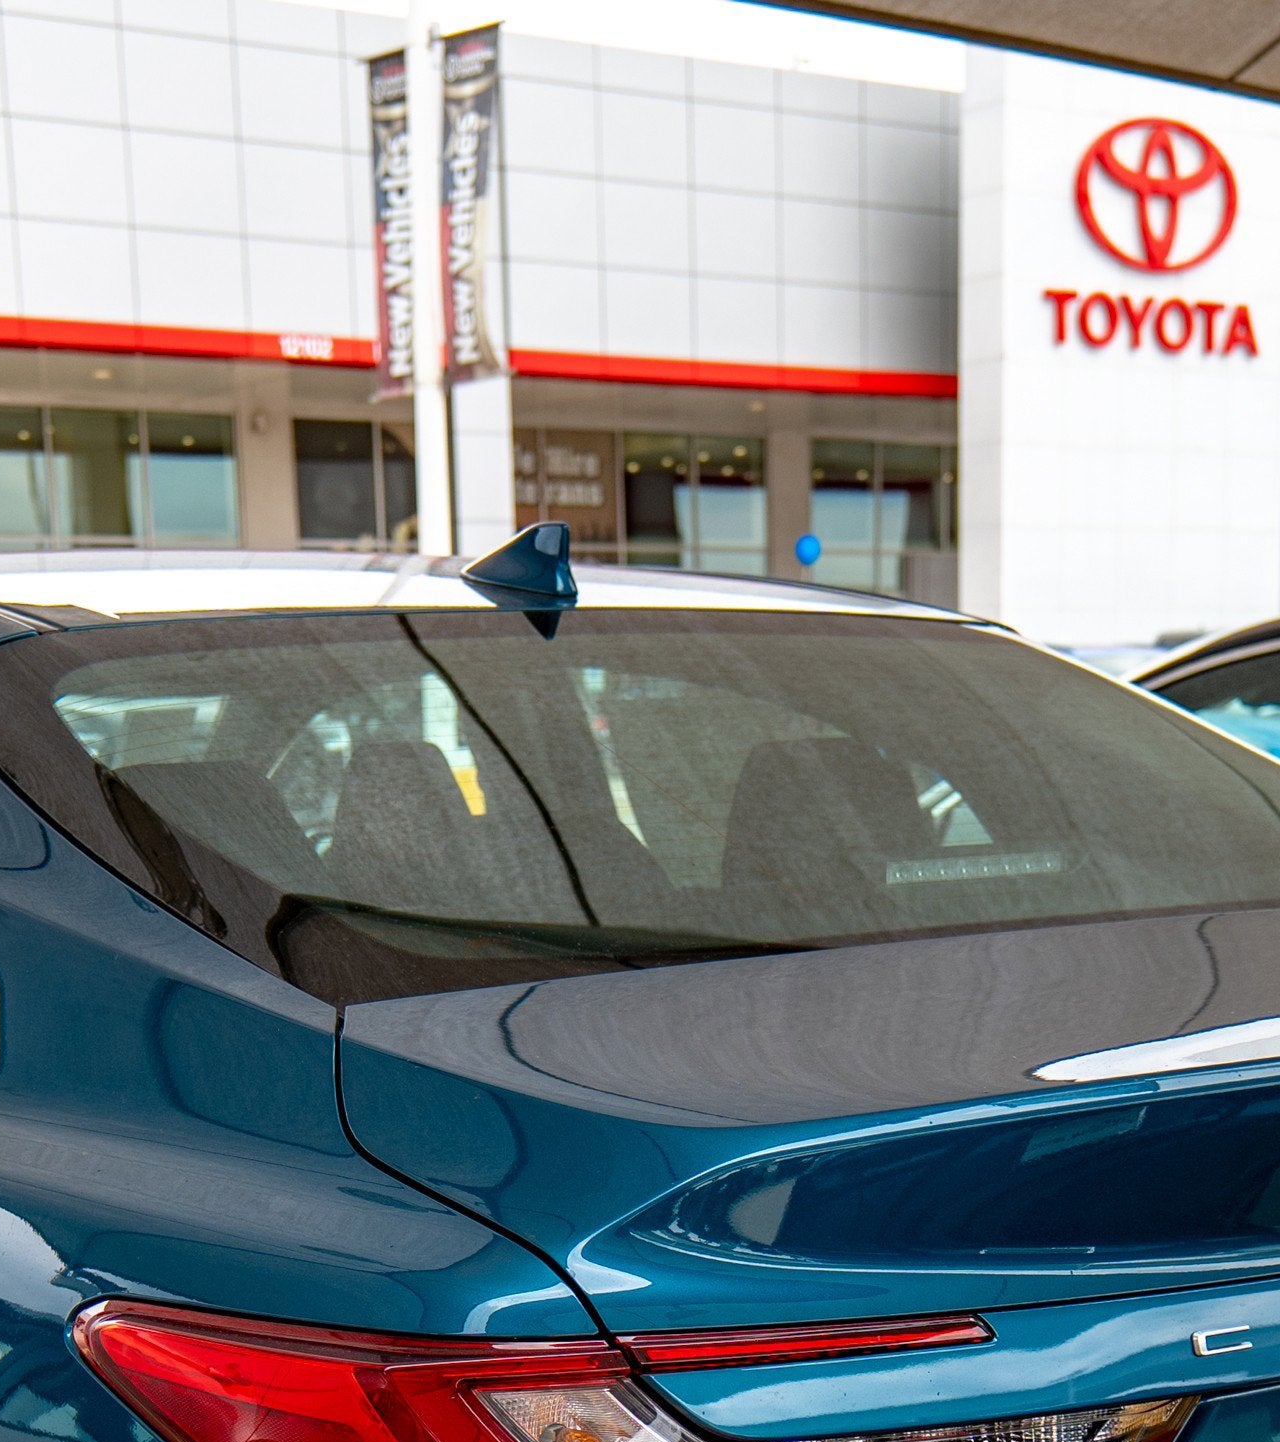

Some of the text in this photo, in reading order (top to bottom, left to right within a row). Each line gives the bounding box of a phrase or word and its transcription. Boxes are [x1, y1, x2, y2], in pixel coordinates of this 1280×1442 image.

[378, 130, 413, 288] Vehicles
[446, 110, 481, 275] Vehicles
[387, 293, 413, 378] New
[451, 278, 480, 366] New
[1042, 288, 1260, 357] TOYOTA
